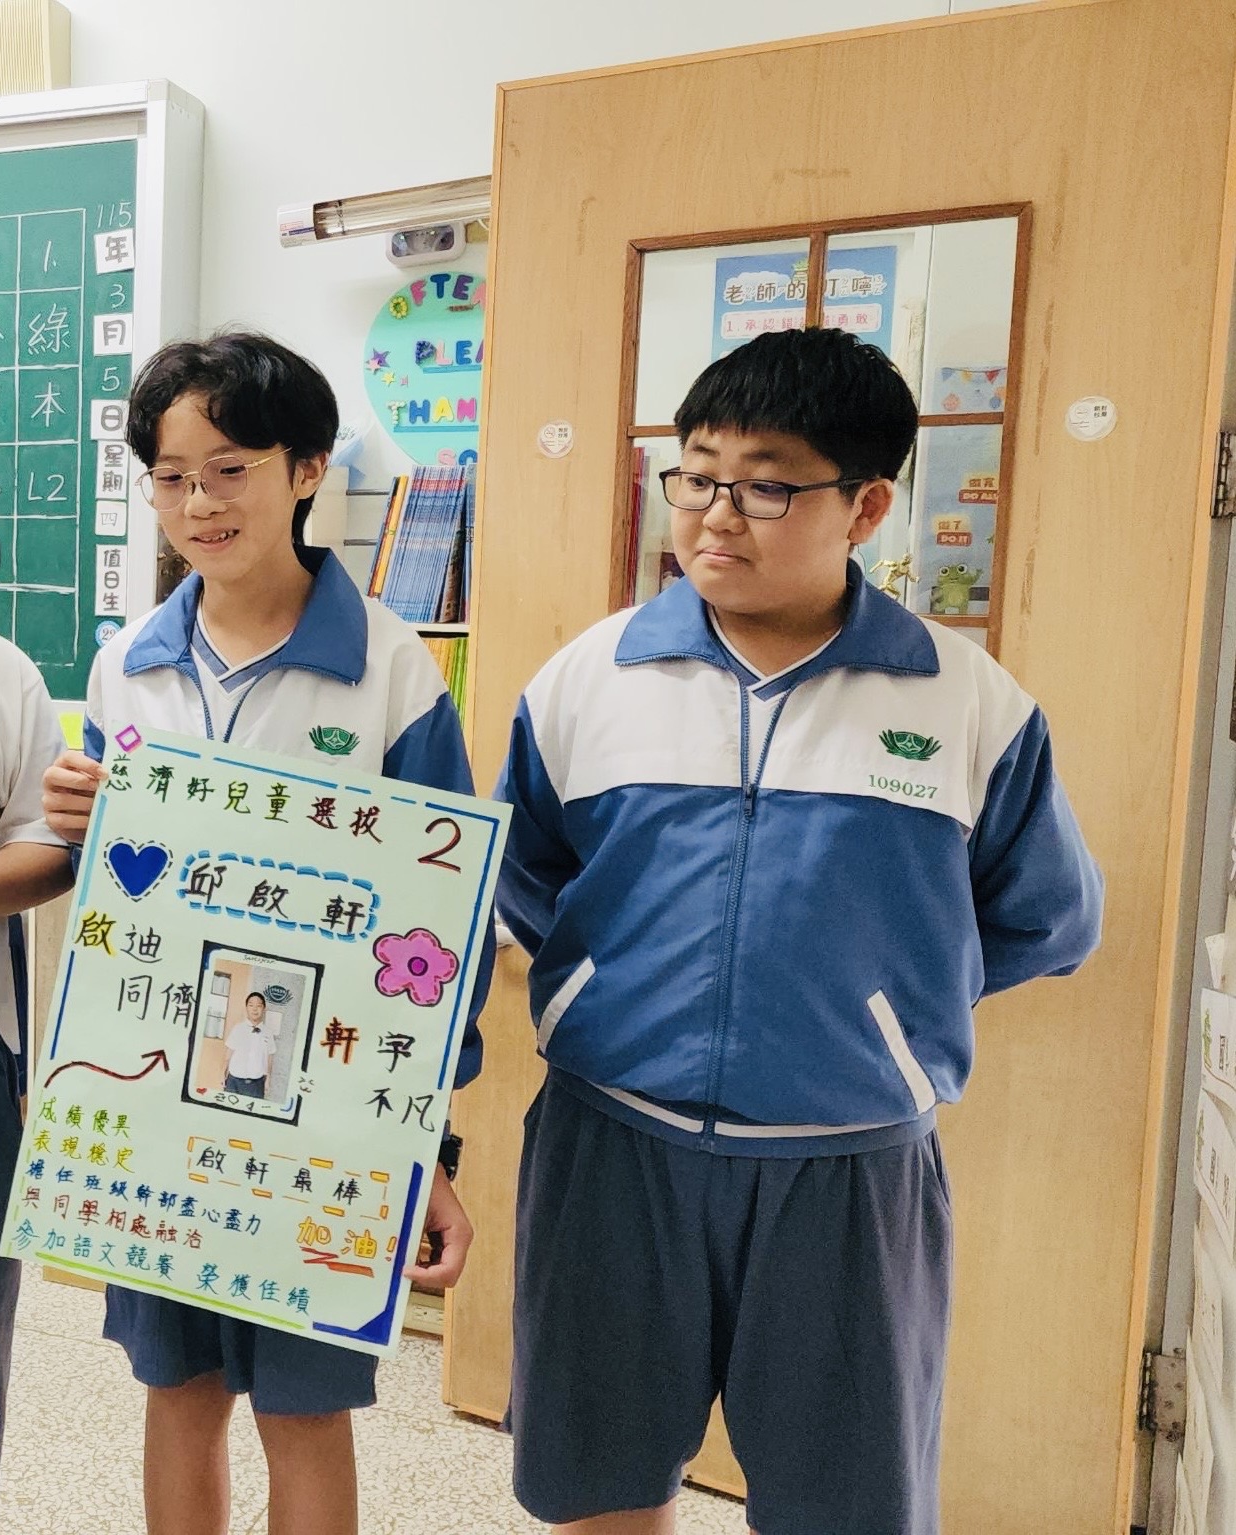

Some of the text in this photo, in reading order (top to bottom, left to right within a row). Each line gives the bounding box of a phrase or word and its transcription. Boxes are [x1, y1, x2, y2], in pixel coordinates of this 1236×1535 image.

[27, 303, 71, 355] 綠
[97, 202, 132, 527] 115 年 3 月 5 日 星期 四
[30, 382, 66, 427] 本
[28, 472, 68, 501] L2
[940, 535, 956, 545] DO
[102, 549, 121, 612] 值日生
[105, 753, 463, 874] 慈濟好兒童選拔 2
[868, 774, 939, 799] 109027
[116, 975, 196, 1030] 同儕
[320, 1016, 416, 1074] 軒宇
[37, 1096, 131, 1139] 成績優異
[364, 1087, 436, 1133] 不凡
[32, 1129, 136, 1174] 表現穩定
[195, 1145, 363, 1206] 啟軒最棒
[21, 1186, 204, 1250] 與同學相處融洽
[25, 1158, 262, 1236] 擔任班級幹部盡心盡力
[11, 1217, 311, 1316] 參加語文競賽 榮獲佳績
